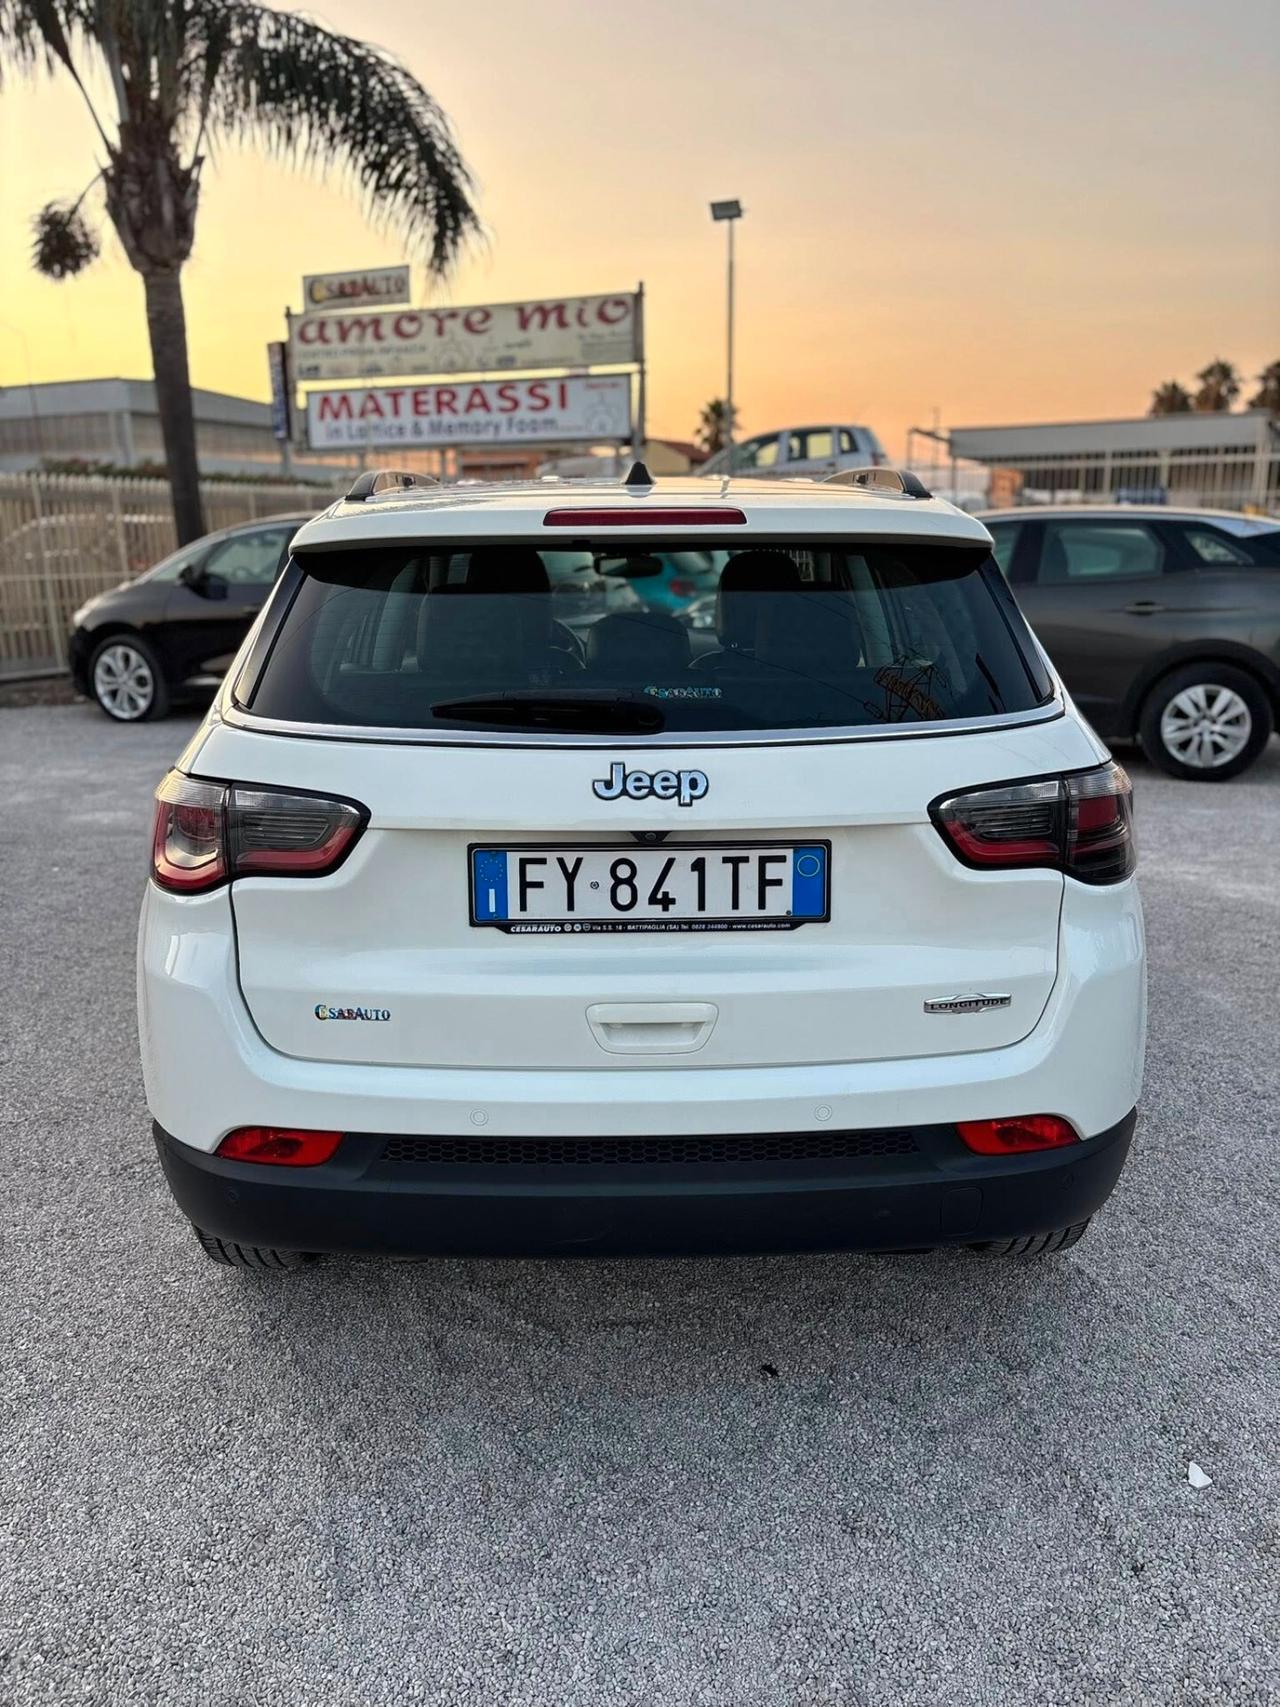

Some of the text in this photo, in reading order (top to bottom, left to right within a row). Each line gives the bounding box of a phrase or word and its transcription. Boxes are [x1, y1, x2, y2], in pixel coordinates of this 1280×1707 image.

[299, 298, 631, 345] amore mio
[318, 382, 569, 422] MATERASSI
[326, 424, 342, 441] in
[410, 419, 424, 436] &
[428, 417, 502, 438] Memory
[592, 762, 709, 807] Jeep
[518, 855, 788, 912] FY 841TF
[510, 925, 562, 933] CESARAUTO
[930, 999, 1008, 1010] LONGITUDE
